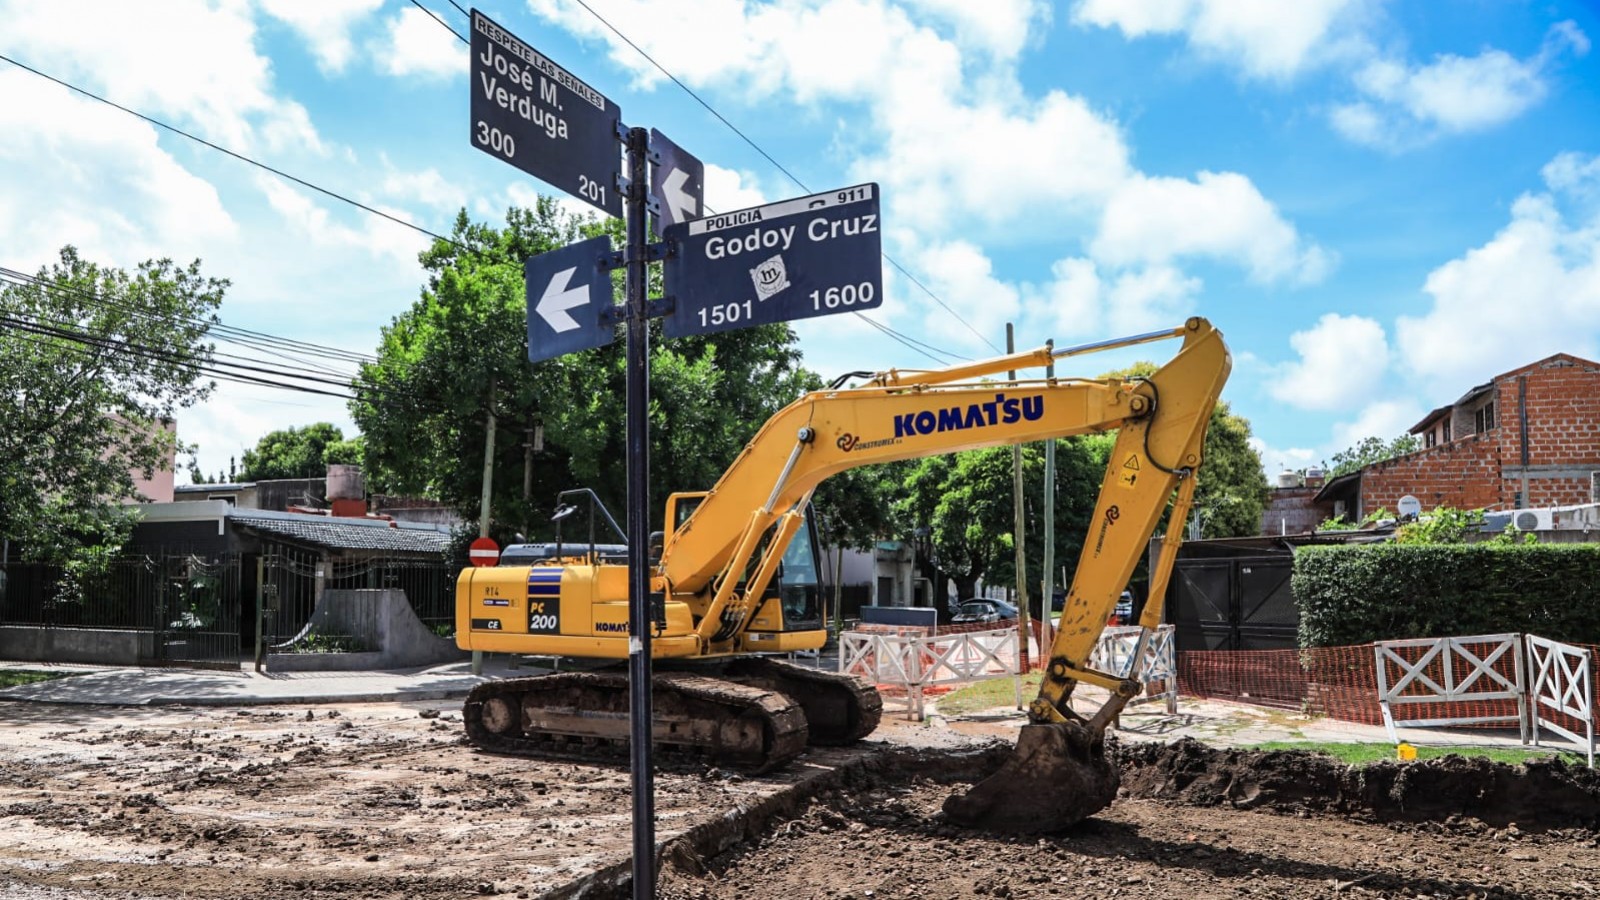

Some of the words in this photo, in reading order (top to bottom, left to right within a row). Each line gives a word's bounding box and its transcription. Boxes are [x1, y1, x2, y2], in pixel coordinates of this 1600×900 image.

[478, 17, 531, 62] RESPETE
[534, 55, 555, 76] LAS
[480, 42, 533, 91] José
[540, 76, 563, 111] M.
[480, 71, 568, 139] Verduga
[477, 120, 515, 158] 300
[578, 174, 606, 206] 201
[705, 208, 763, 232] POLICIA
[838, 188, 865, 204] 911
[705, 225, 796, 260] Godoy
[807, 214, 878, 242] Cruz
[697, 299, 753, 327] 1501
[809, 281, 875, 310] 1600
[893, 393, 1044, 438] KOMATSU
[487, 621, 499, 629] CE
[530, 602, 545, 613] PC
[530, 614, 557, 630] 200
[595, 621, 630, 632] KOMAT
